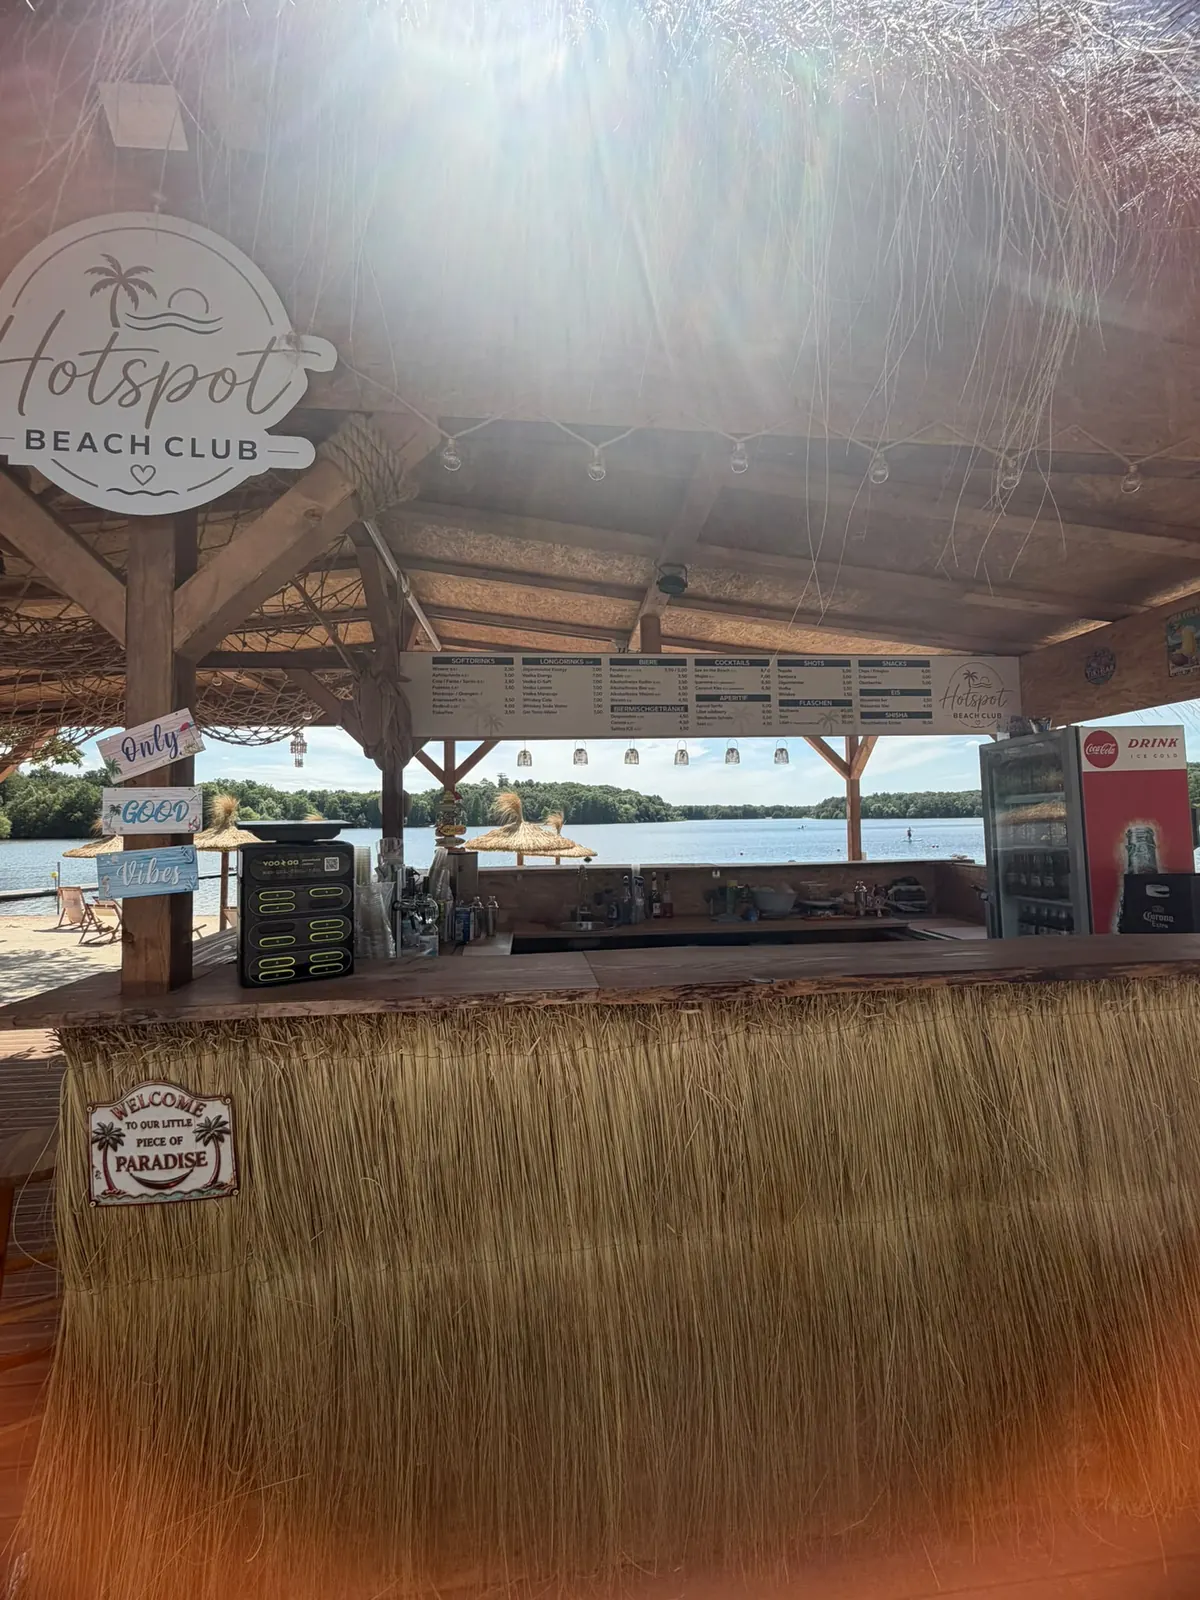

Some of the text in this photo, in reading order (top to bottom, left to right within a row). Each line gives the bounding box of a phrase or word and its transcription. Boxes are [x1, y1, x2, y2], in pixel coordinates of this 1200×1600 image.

[0, 309, 321, 429] Hotspot
[25, 429, 258, 460] BEACH CLUB
[939, 684, 1014, 712] Hotspot
[121, 723, 180, 763] Only
[1086, 743, 1116, 755] Coca-Cola
[1128, 738, 1179, 748] DRINK
[121, 800, 190, 824] GOOD
[116, 857, 181, 887] Vibes
[1143, 910, 1175, 923] Corona
[110, 1091, 207, 1121] WELCOME
[126, 1118, 193, 1130] TO OUR LITTLE
[136, 1136, 184, 1148] PIECE OF
[115, 1151, 208, 1172] PARADISE
